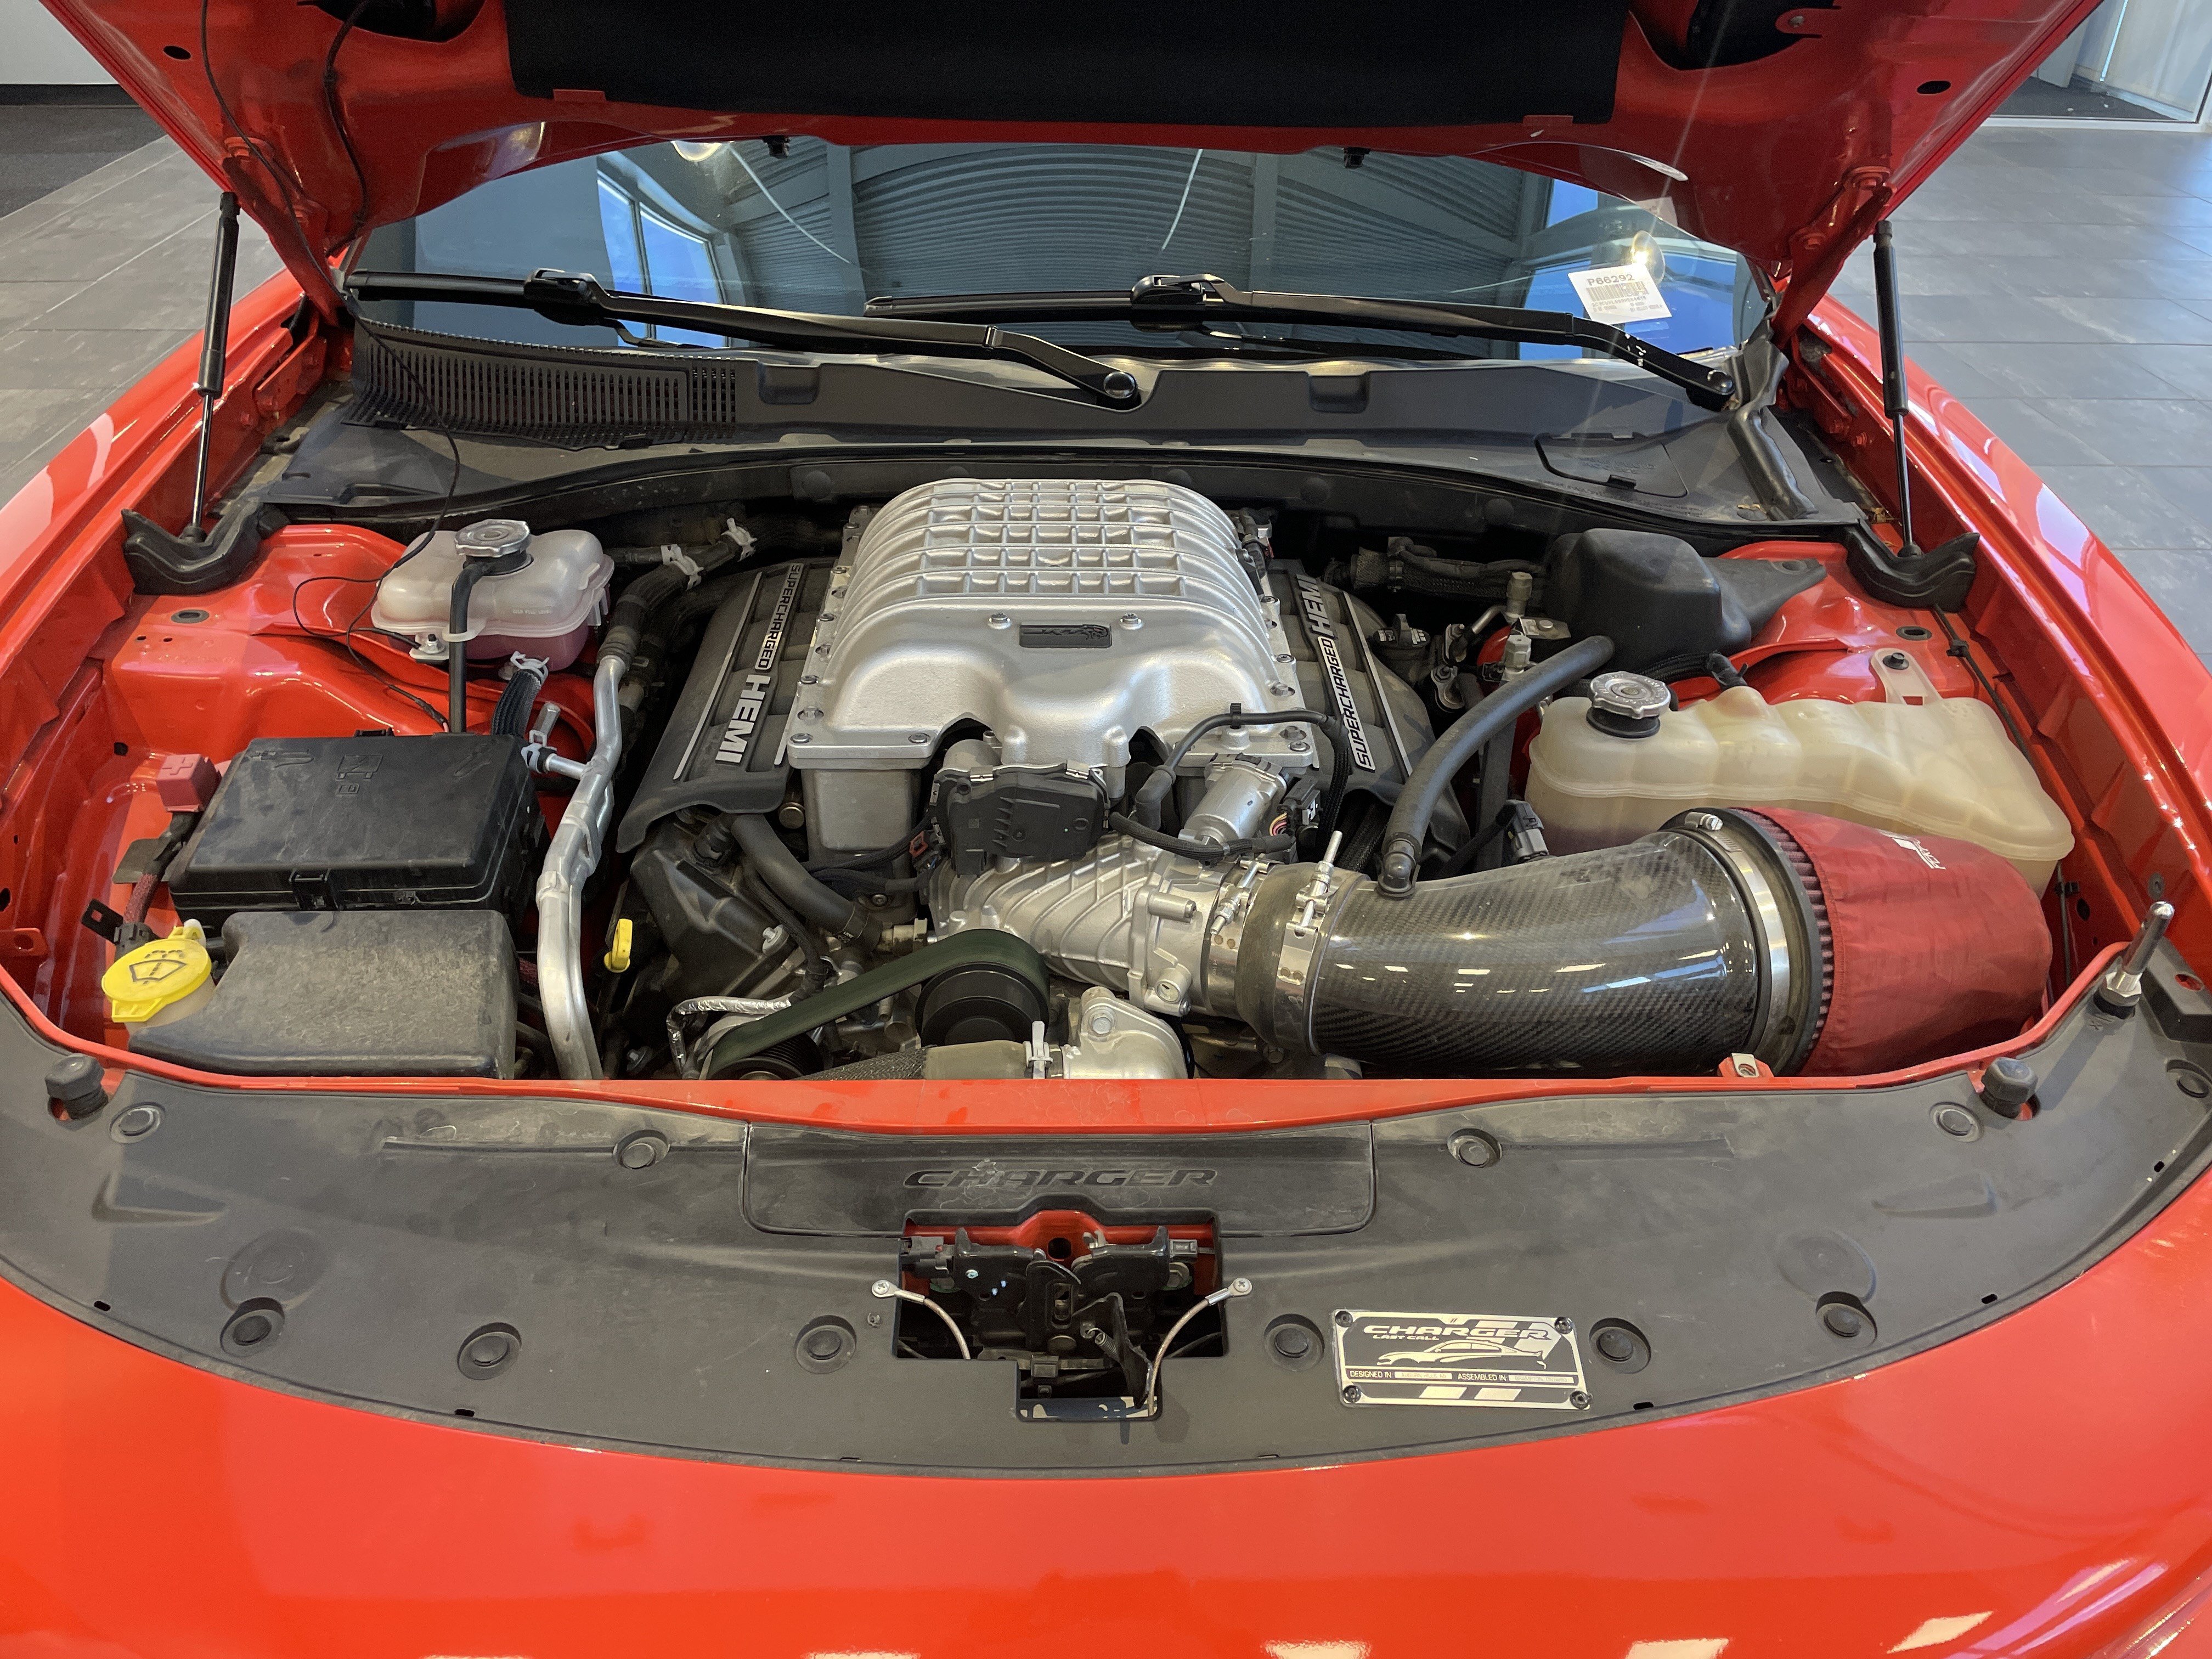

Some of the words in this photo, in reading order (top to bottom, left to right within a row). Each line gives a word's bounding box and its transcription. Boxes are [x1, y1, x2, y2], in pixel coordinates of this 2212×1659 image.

[1587, 274, 1635, 286] P66292
[757, 564, 803, 669] SUPERCHARGED
[1296, 574, 1336, 639] HEMI
[715, 674, 771, 763] HEMI
[1321, 639, 1372, 767] SUPERCHARGED
[903, 1169, 1218, 1188] CHARGER
[1363, 1325, 1553, 1340] CHARGER
[1458, 1373, 1498, 1381] ASSEMBLED
